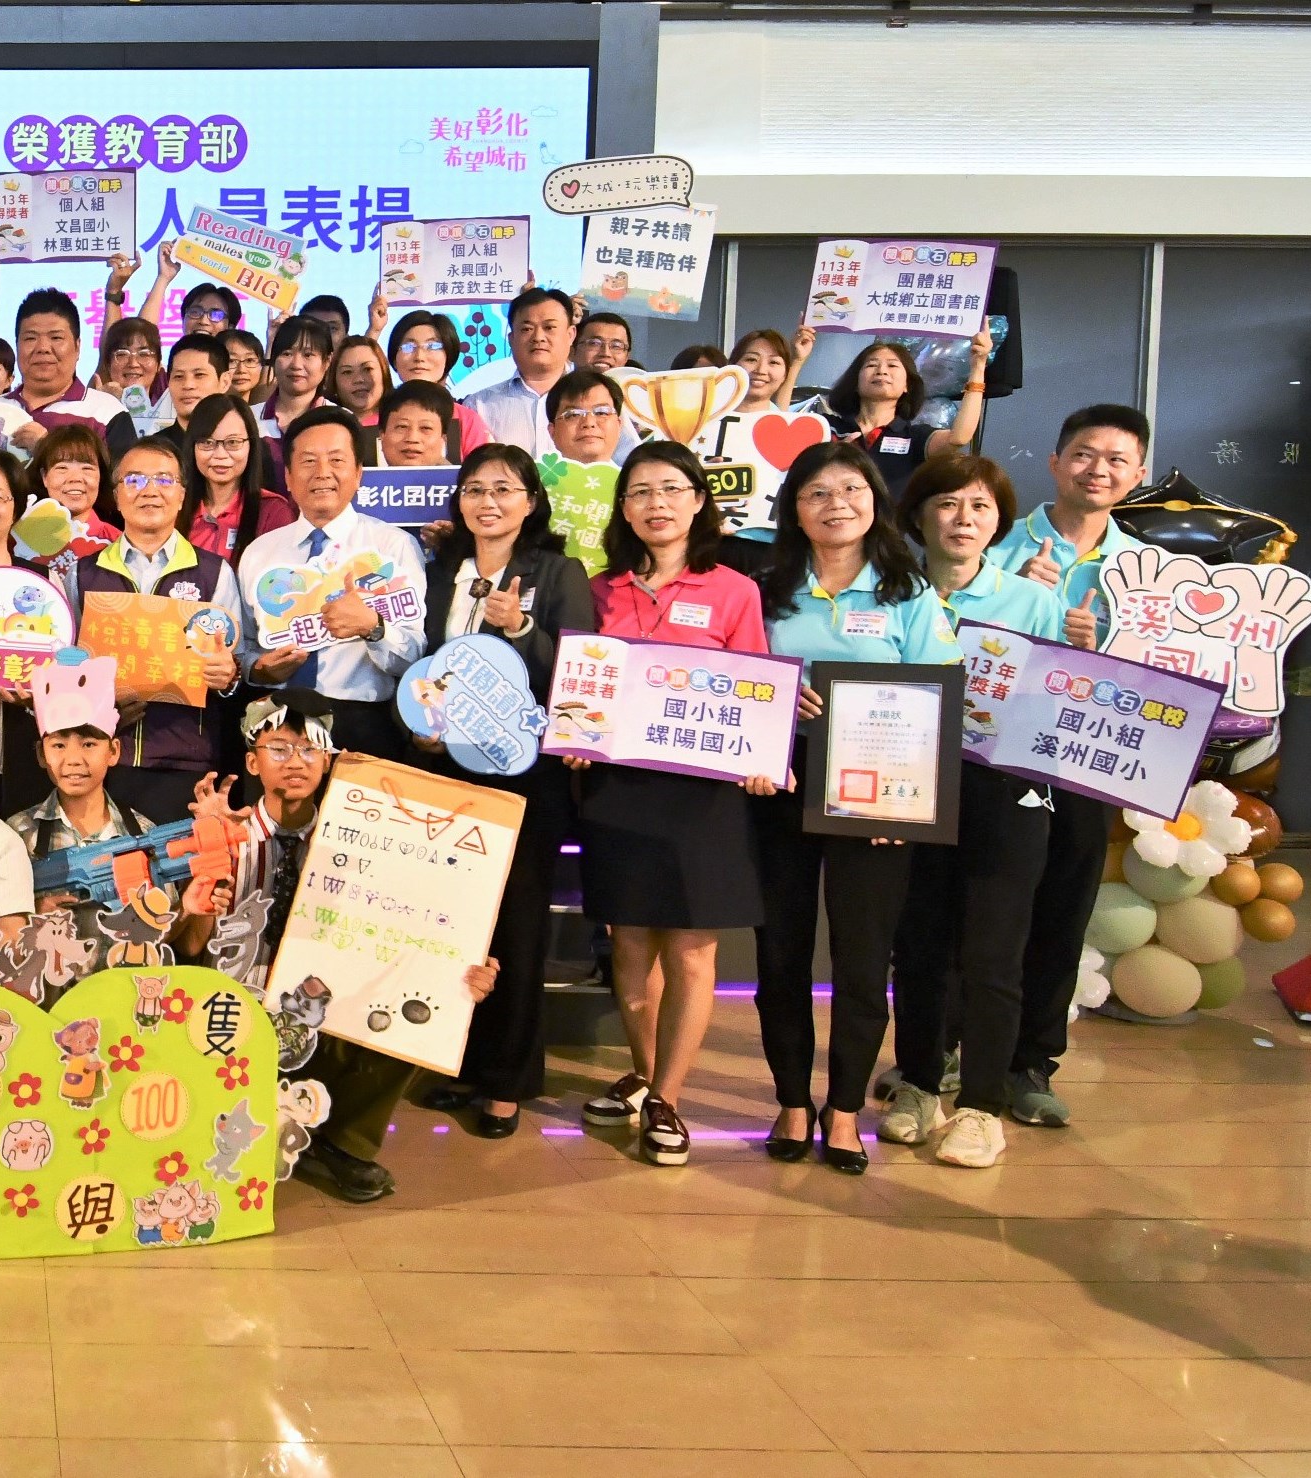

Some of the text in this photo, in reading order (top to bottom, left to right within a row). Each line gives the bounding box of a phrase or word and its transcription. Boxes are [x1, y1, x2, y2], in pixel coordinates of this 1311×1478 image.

[429, 107, 528, 141] 美好彰化
[11, 124, 240, 166] 榮獲教育部
[443, 145, 527, 172] 希望城市
[58, 196, 105, 213] 個人組
[55, 217, 110, 234] 文昌國小
[195, 212, 292, 258] Reading
[610, 217, 693, 242] 親子共讀
[43, 236, 121, 253] 林惠如主任
[203, 238, 269, 268] makes your
[386, 240, 421, 251] 113年
[451, 242, 498, 258] 個人組
[385, 253, 421, 265] 得獎者
[446, 262, 503, 277] 永興國小
[596, 246, 698, 273] 也是種陪伴
[821, 261, 861, 273] 113年
[199, 255, 280, 300] world BIG
[434, 279, 514, 296] 陳茂欽主任
[817, 274, 859, 287] 得獎者
[896, 272, 954, 290] 團體組
[866, 291, 981, 311] 大城鄉立圖書館
[356, 485, 459, 508] 彰化囝仔
[565, 661, 618, 680] 113年
[561, 677, 616, 699] 得獎者
[663, 697, 742, 727] 國小組
[645, 723, 752, 756] 螺陽國小
[1055, 707, 1146, 752] 國小組
[1031, 732, 1147, 782] 溪州國小
[202, 991, 242, 1057] 隻
[132, 1078, 179, 1130] 100
[66, 1184, 114, 1239] 與
